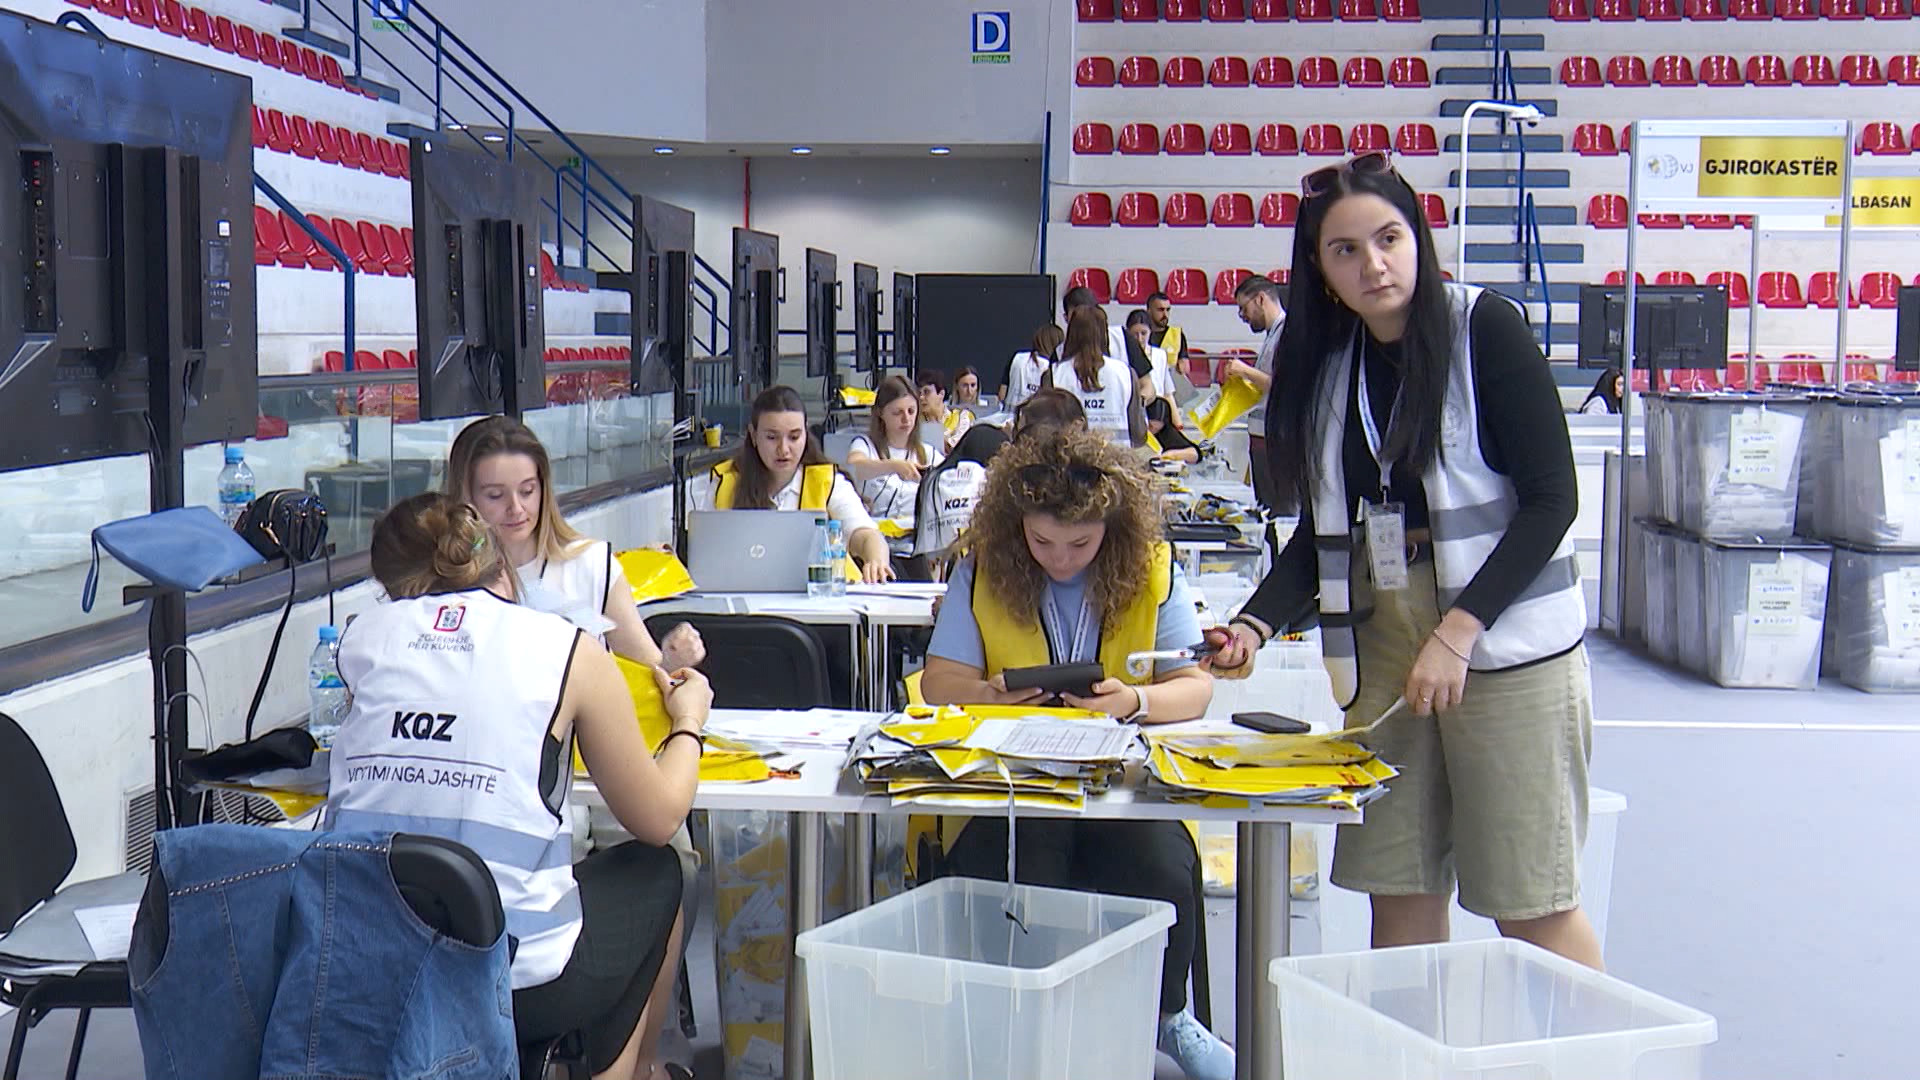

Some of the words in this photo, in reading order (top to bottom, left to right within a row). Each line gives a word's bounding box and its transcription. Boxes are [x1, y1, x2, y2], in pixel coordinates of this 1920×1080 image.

[977, 14, 1006, 50] D
[1679, 163, 1694, 174] VJ
[1705, 156, 1838, 176] GJIROKASTËR
[1851, 195, 1912, 209] LBASAN
[1084, 399, 1105, 409] KQZ
[944, 498, 969, 511] KQZ
[391, 711, 457, 742] KQZ
[391, 766, 425, 784] NGA
[428, 769, 497, 794] JASHTË
